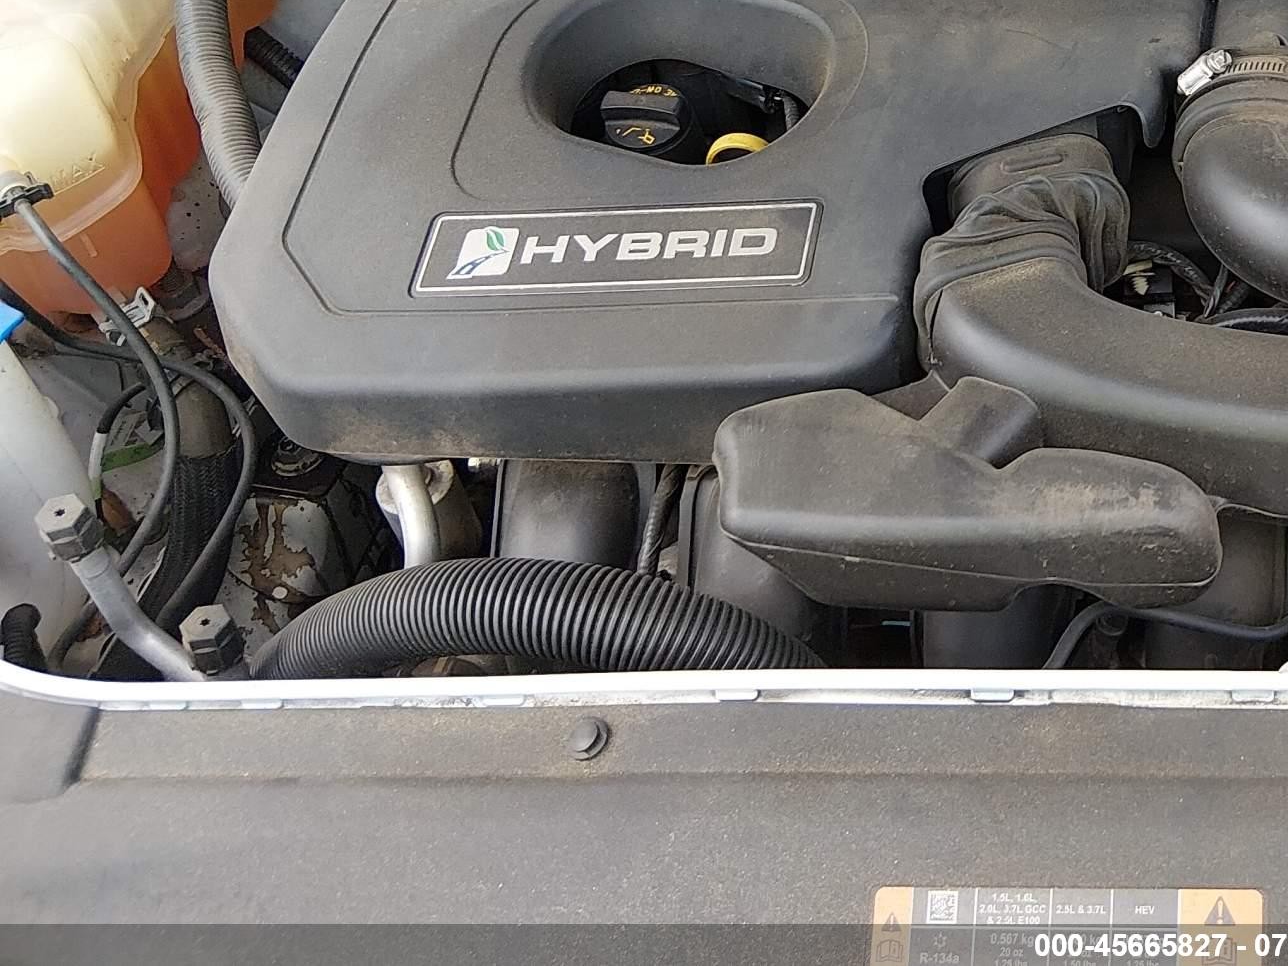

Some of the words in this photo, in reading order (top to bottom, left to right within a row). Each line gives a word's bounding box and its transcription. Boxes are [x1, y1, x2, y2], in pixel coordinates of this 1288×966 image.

[519, 227, 778, 264] HYBRID
[1025, 904, 1046, 914] GCC
[1078, 905, 1085, 914] &
[1086, 905, 1106, 914] 3.7L
[1134, 906, 1155, 915] HEV
[1018, 916, 1040, 924] E100
[990, 933, 1018, 945] 0.567
[1021, 933, 1034, 947] kg
[1013, 949, 1023, 957] oz
[919, 952, 960, 964] R-134a
